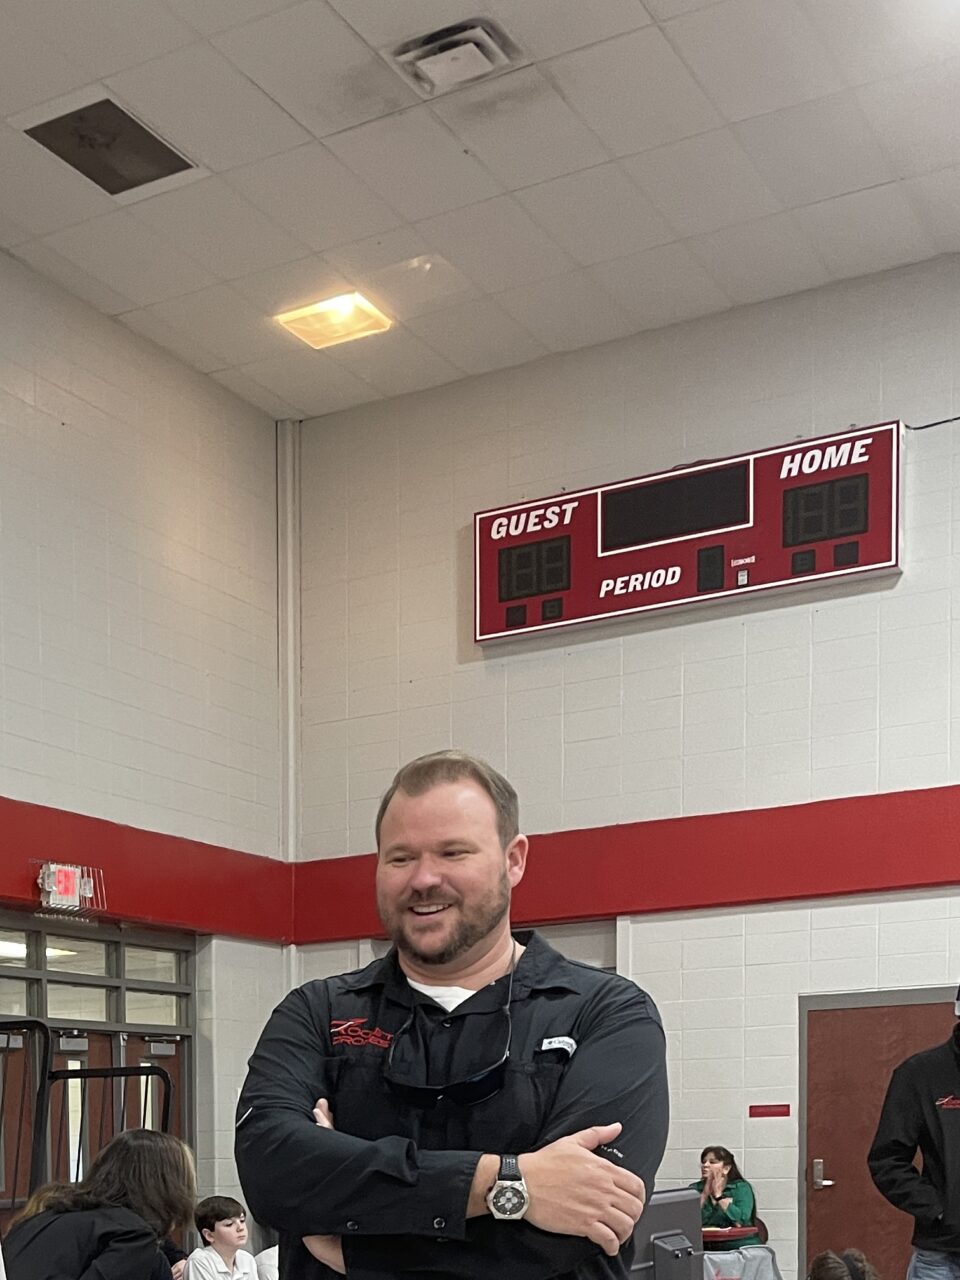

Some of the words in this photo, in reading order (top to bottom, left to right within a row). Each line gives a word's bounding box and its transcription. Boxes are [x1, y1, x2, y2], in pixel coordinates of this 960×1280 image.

[780, 438, 873, 479] HOME
[490, 501, 579, 540] GUEST
[599, 566, 681, 598] PERIOD
